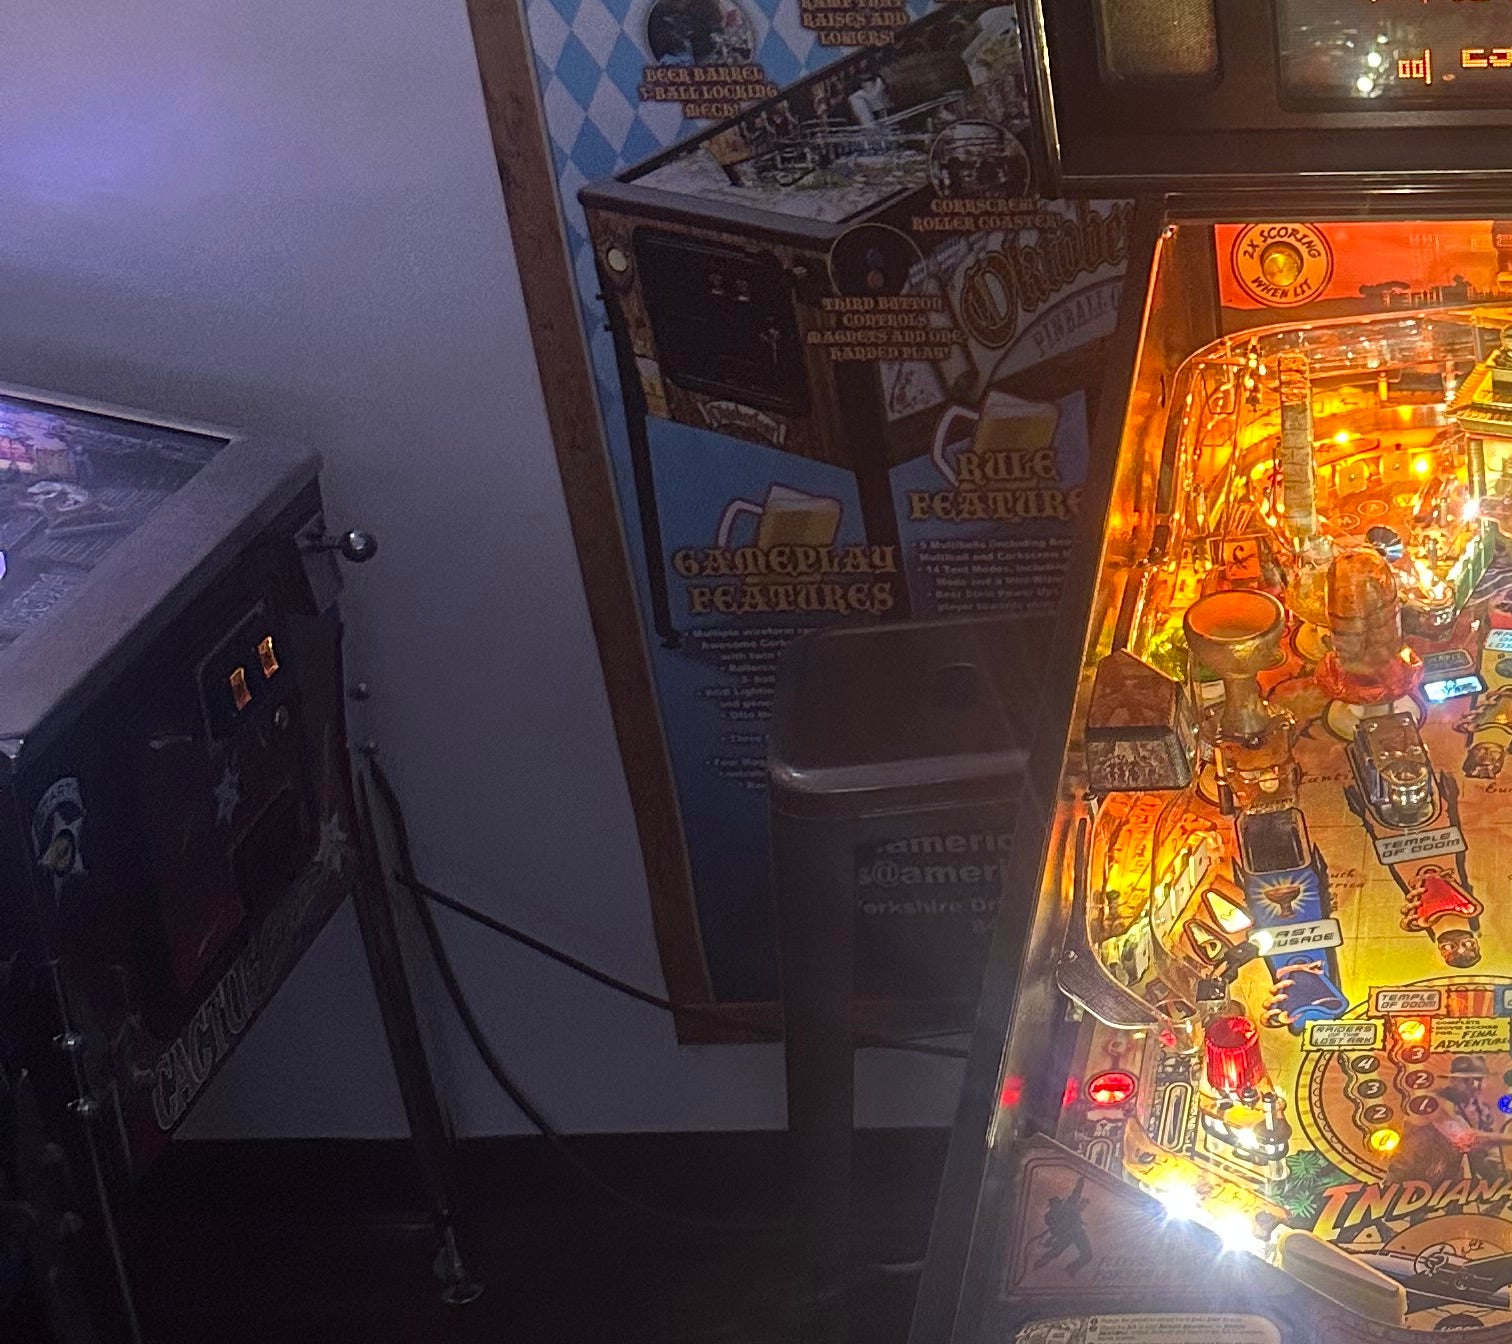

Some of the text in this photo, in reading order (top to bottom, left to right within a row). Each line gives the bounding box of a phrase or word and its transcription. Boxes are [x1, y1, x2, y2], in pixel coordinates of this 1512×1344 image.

[803, 11, 907, 27] RAISES AND
[820, 31, 895, 46] LOWERS!
[645, 66, 764, 83] BEER BARREL
[702, 84, 778, 99] LOCKING
[912, 216, 977, 231] ROLLER
[1243, 225, 1322, 260] 2X SCORING
[1251, 275, 1313, 299] WHEN LIT
[822, 296, 942, 311] THIRD BUTTON
[843, 313, 927, 327] CONTROLS
[807, 330, 927, 345] MAGNETS AND
[956, 449, 1060, 485] RULE
[671, 544, 898, 577] GAMEPLAY
[687, 582, 896, 614] FEATURES
[1382, 833, 1451, 849] TEMPLE
[1382, 838, 1462, 858] OF DOOM
[1380, 993, 1437, 1002] TEMPLE
[1380, 1000, 1437, 1009] OF DOOM
[1315, 1025, 1372, 1033] RAIDERS
[1461, 1029, 1498, 1040] FINAL
[1314, 1036, 1373, 1045] LOST ARK
